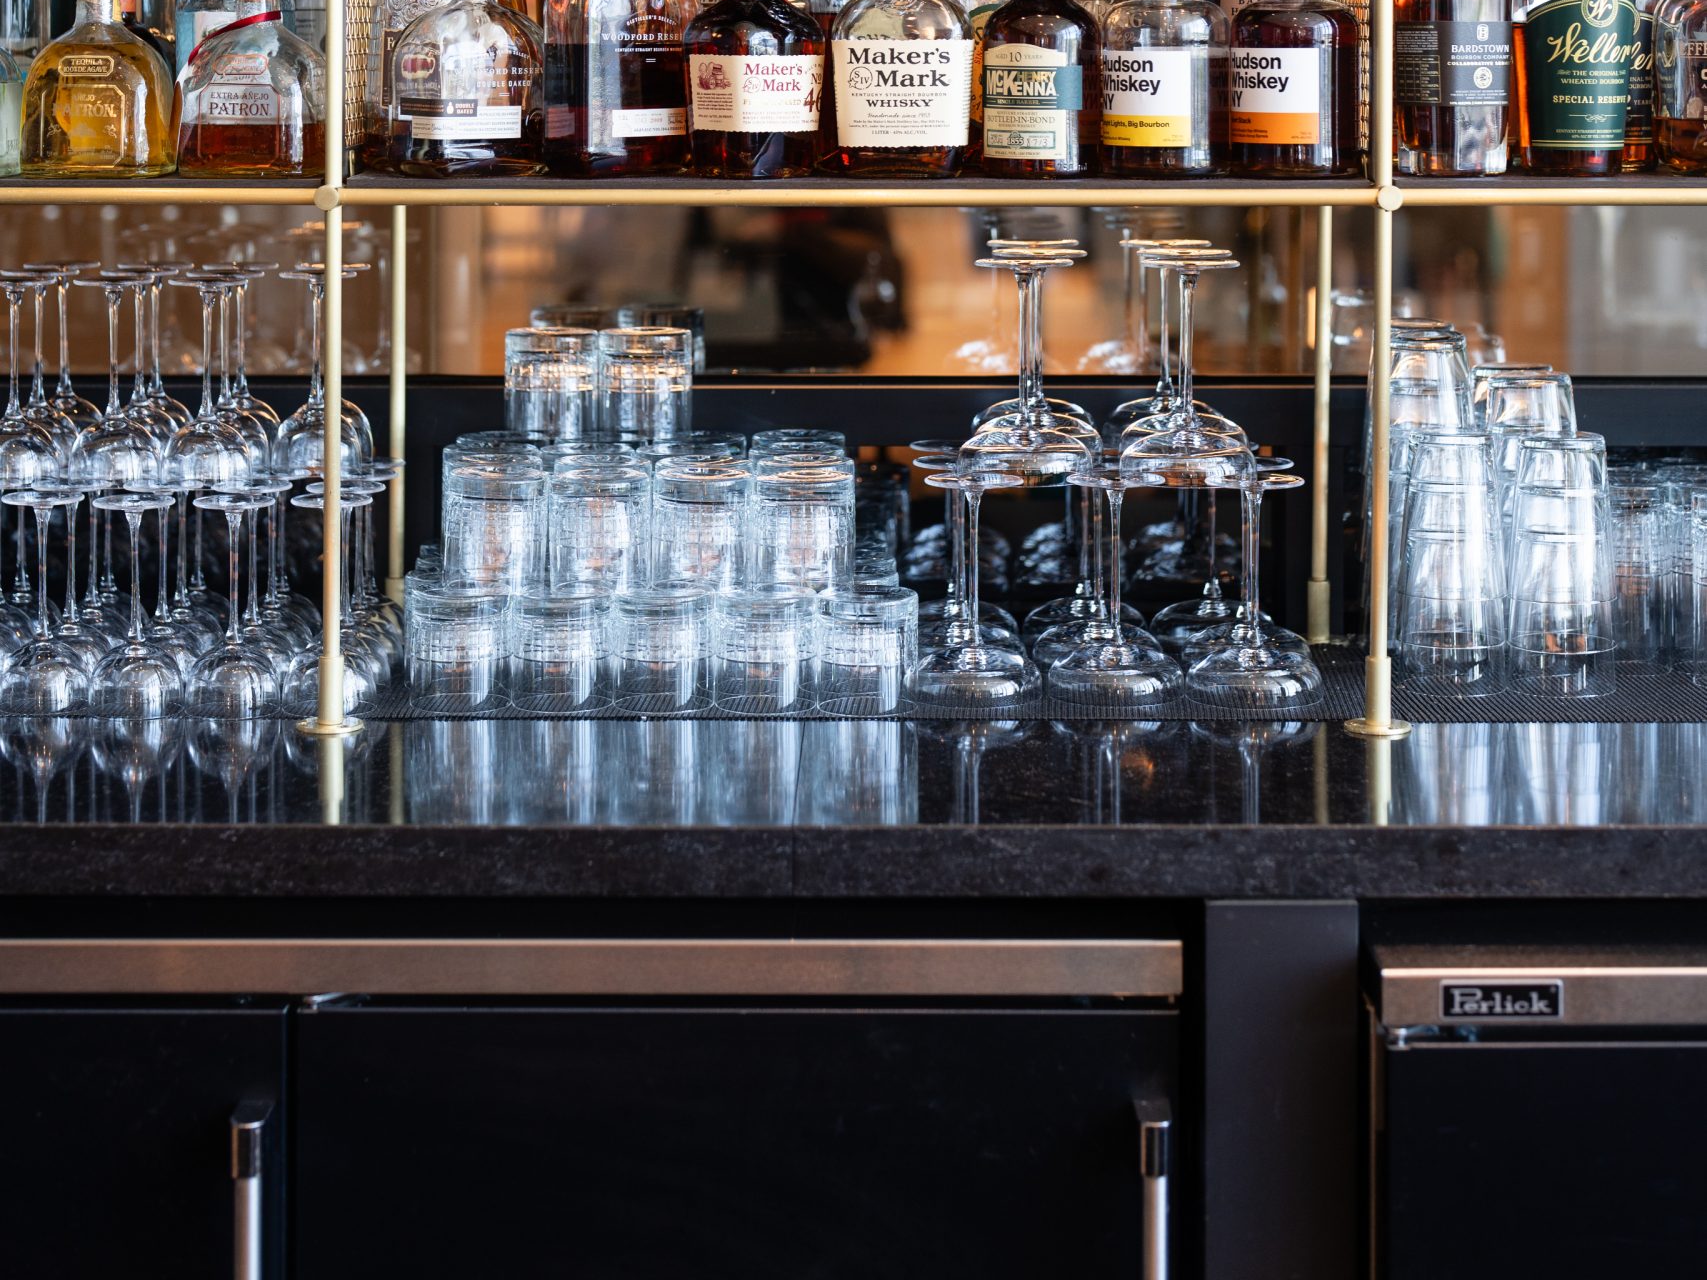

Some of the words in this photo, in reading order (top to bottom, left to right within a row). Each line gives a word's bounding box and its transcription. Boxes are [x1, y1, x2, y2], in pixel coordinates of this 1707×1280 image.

[602, 33, 655, 41] WOODFORD
[1452, 45, 1510, 53] BARDSTOWN
[1547, 23, 1632, 64] Weller
[847, 48, 951, 65] Maker's
[1010, 52, 1022, 63] 10
[1232, 53, 1282, 70] Hudson
[744, 64, 803, 76] Maker's
[1103, 56, 1153, 73] Hudson
[477, 80, 506, 88] DOUBLE
[874, 70, 950, 87] Mark
[1232, 72, 1289, 92] Whiskey
[762, 79, 801, 92] Mark
[1103, 75, 1161, 95] Whiskey
[242, 91, 269, 100] AÑEJO
[1553, 95, 1595, 103] SPECIAL
[1598, 96, 1627, 104] RESERVE
[209, 100, 271, 117] PATRÓN
[866, 100, 934, 108] WHISKY
[987, 116, 1055, 124] BOTTLED-IN-BOND
[1128, 121, 1138, 129] Big
[1008, 137, 1024, 146] 1855
[1450, 988, 1552, 1015] Perlick
